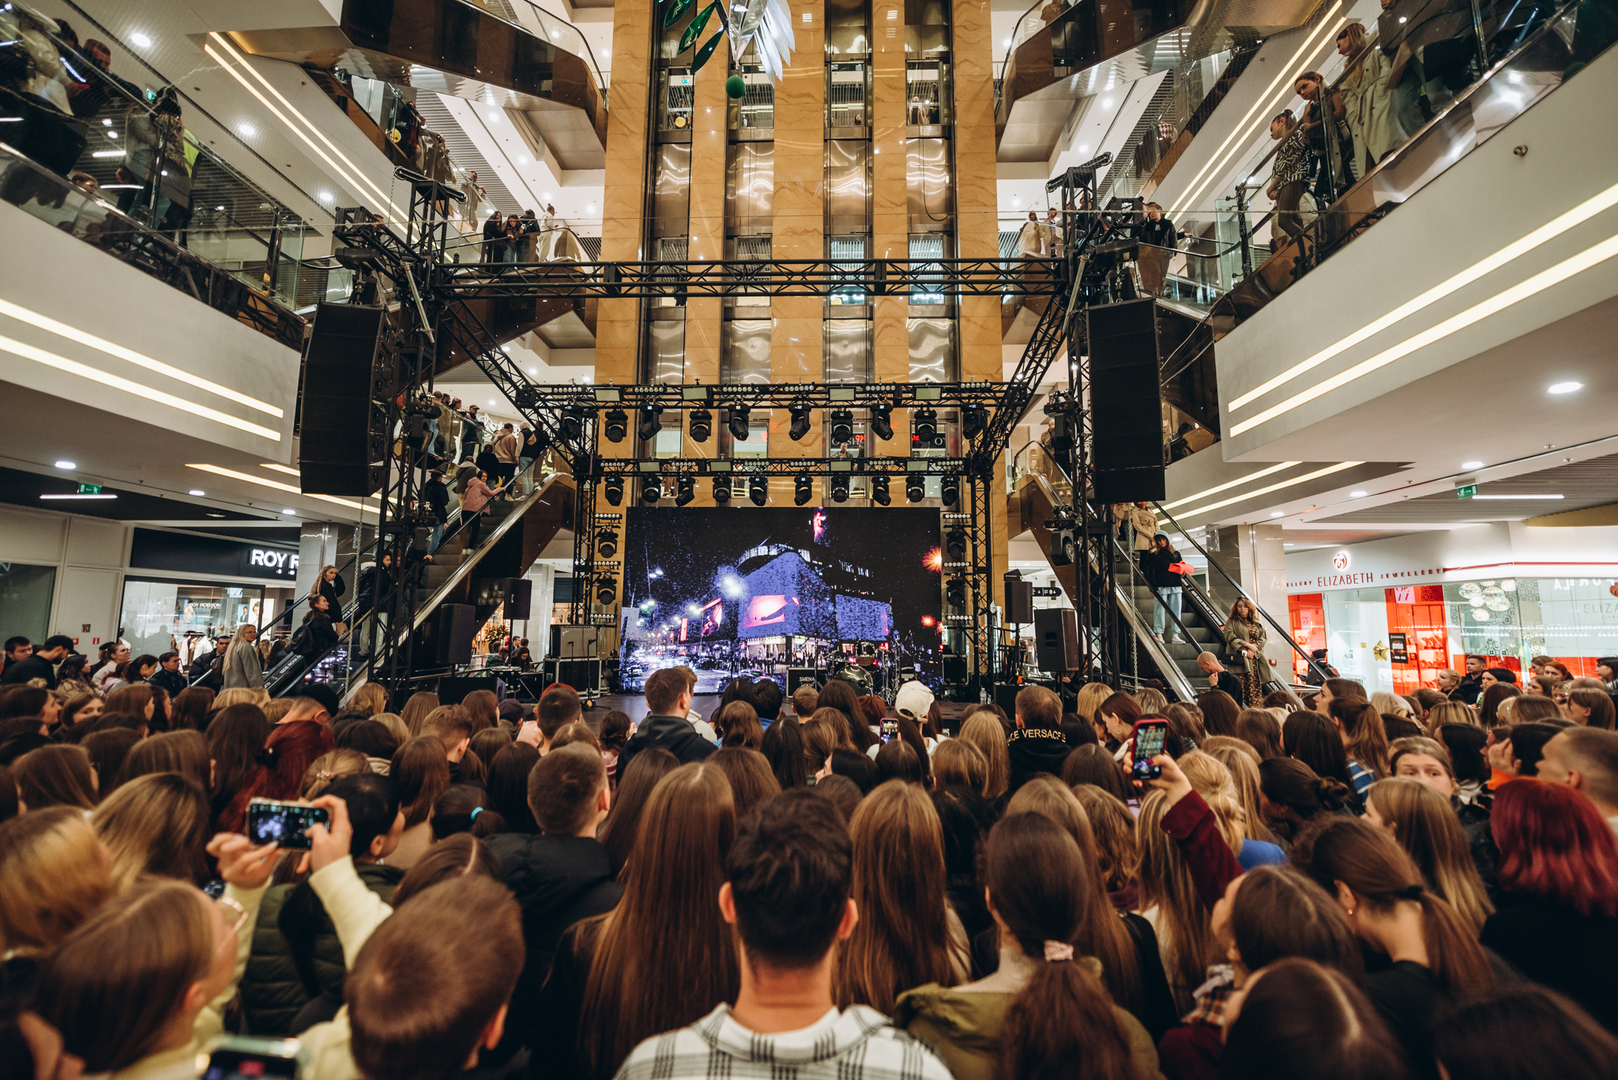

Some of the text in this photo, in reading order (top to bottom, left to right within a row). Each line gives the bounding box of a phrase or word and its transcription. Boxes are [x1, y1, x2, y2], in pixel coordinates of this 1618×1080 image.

[251, 549, 287, 568] ROY
[1317, 572, 1374, 588] ELIZABETH
[1380, 568, 1440, 580] JEWELLERY
